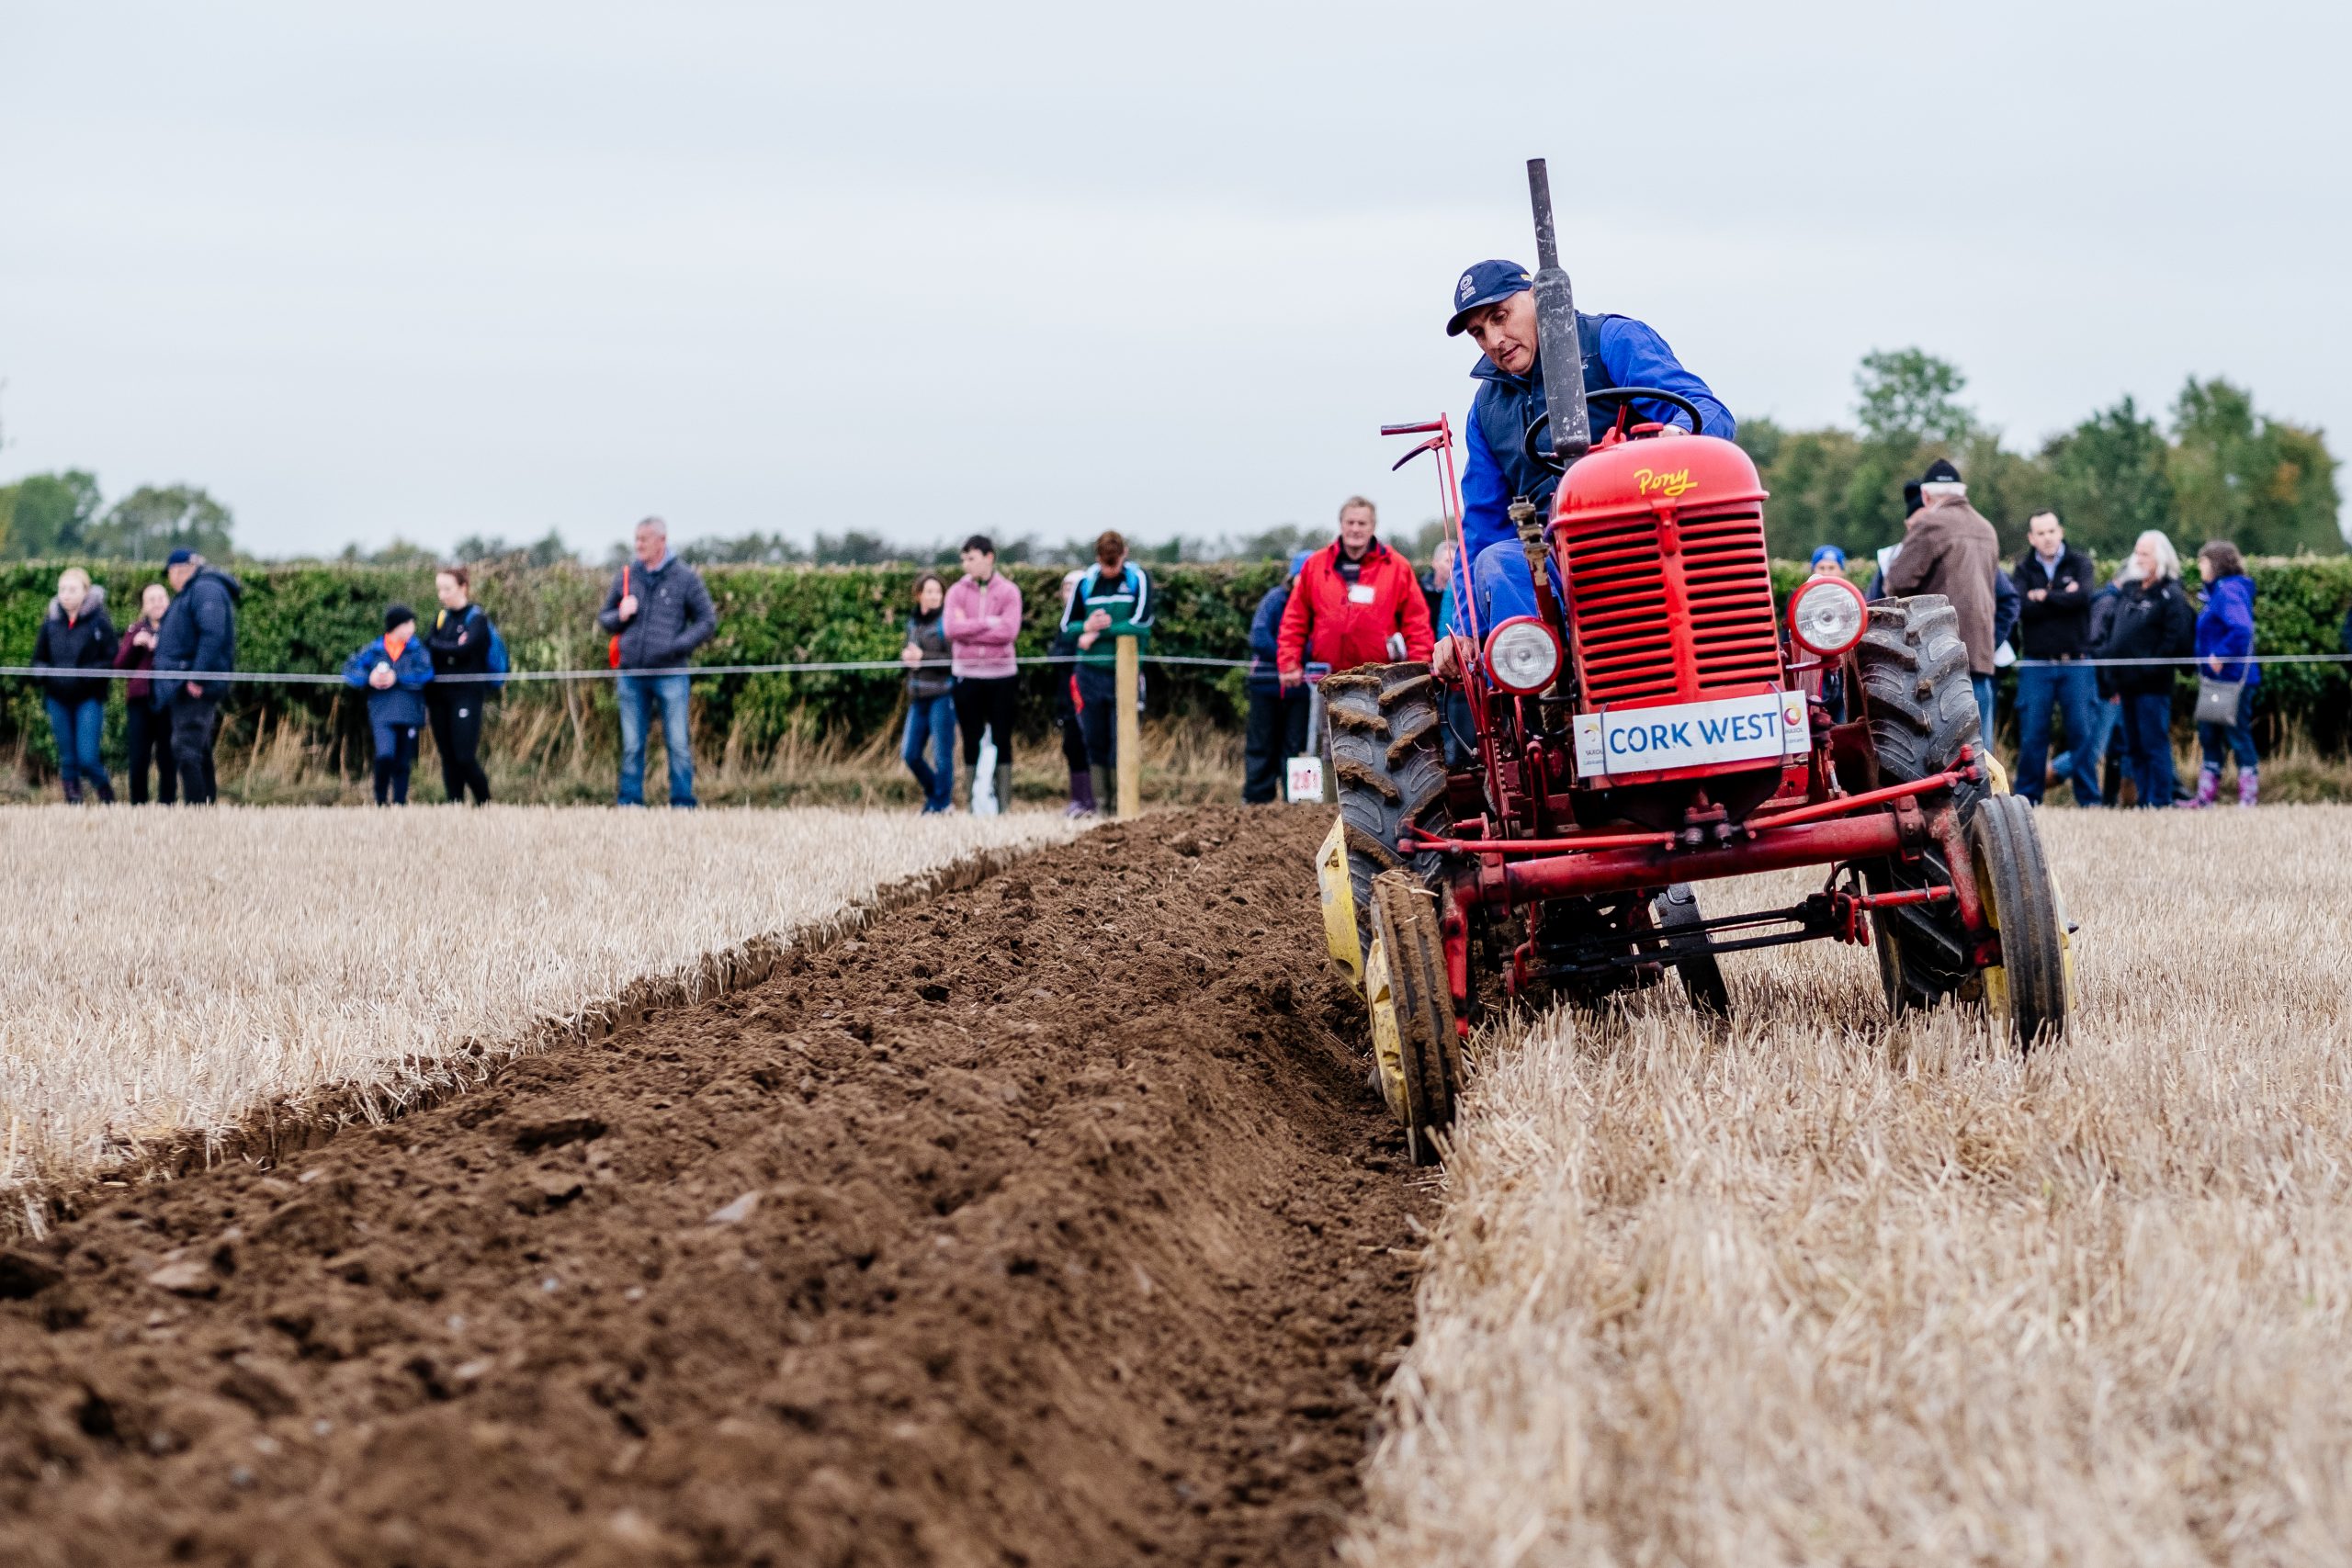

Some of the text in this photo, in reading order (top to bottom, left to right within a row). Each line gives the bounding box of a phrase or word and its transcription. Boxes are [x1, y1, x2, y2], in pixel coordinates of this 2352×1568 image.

[1634, 468, 1698, 496] Pony
[1610, 712, 1778, 754] CORK WEST
